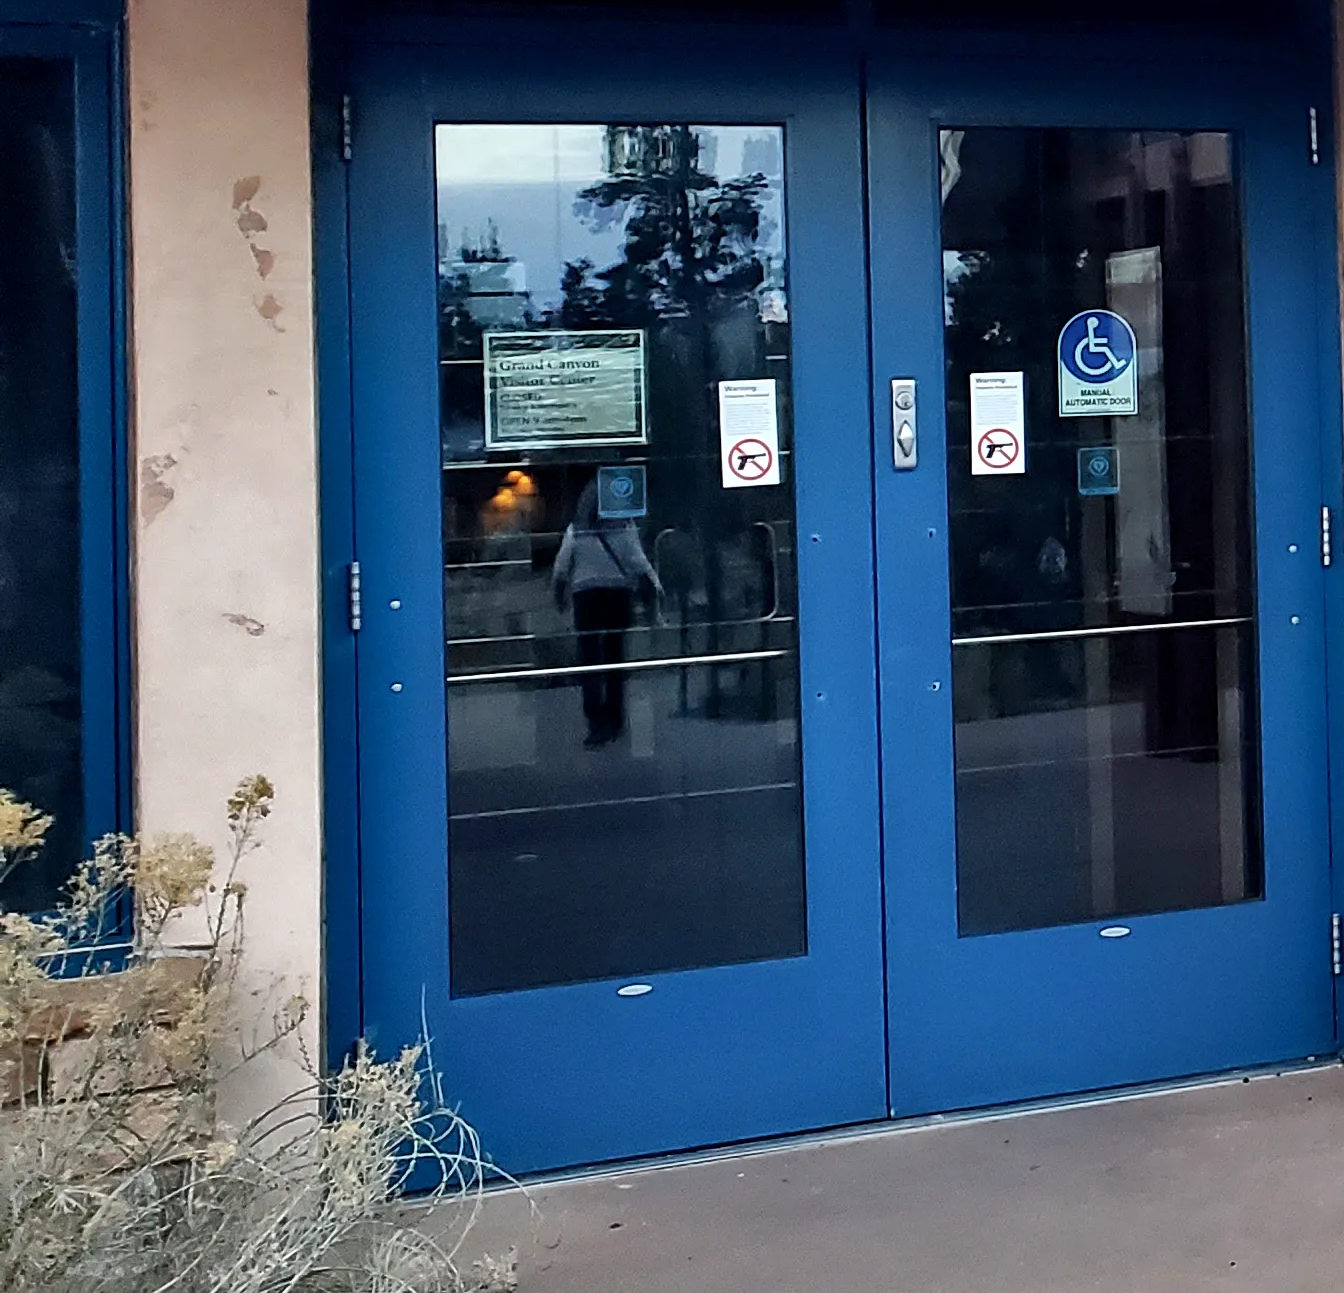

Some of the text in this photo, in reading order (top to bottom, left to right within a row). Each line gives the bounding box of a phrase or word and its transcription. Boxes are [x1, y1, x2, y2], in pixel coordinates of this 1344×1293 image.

[500, 358, 600, 371] Grand Canyon
[1080, 388, 1112, 397] MANUAL
[1065, 397, 1132, 407] AUTOMATIC DOOR
